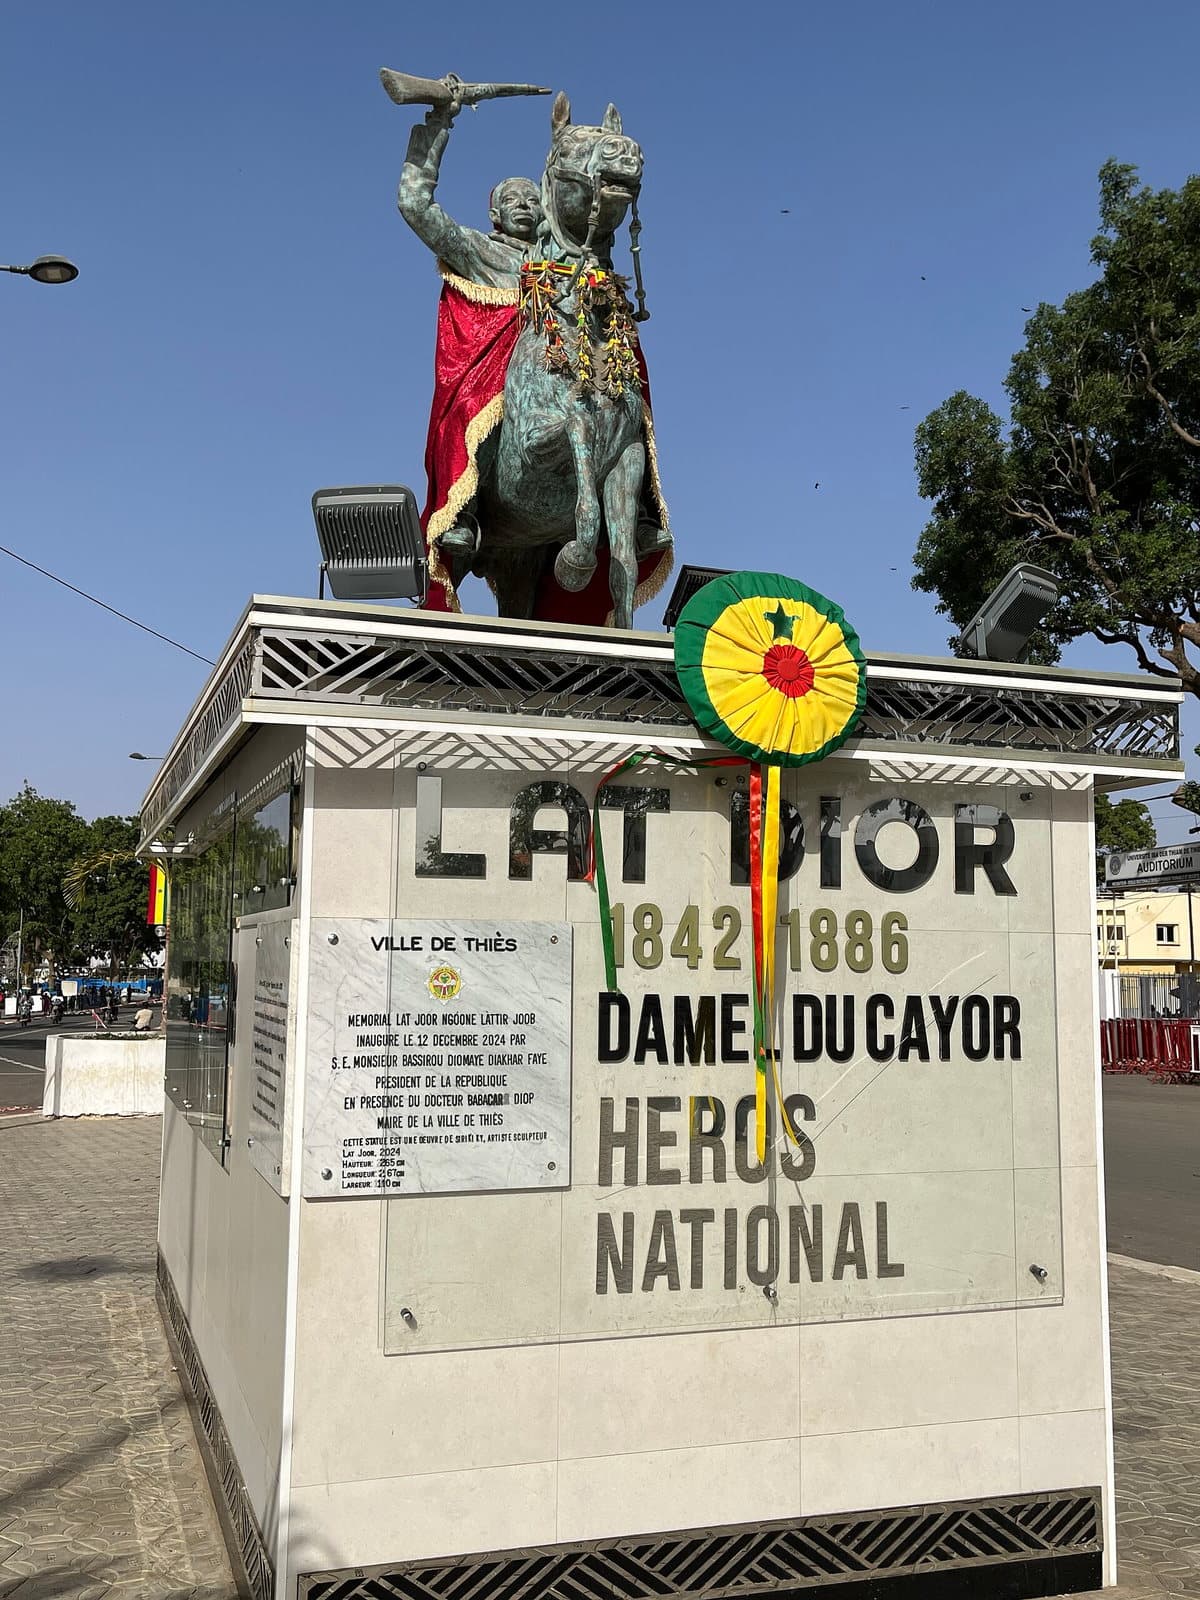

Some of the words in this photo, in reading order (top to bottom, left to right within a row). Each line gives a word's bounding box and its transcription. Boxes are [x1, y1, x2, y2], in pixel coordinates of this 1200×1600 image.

[415, 775, 670, 884] LAT
[731, 791, 1018, 896] DIOR
[1137, 857, 1193, 873] AUDITORIUM
[371, 936, 423, 951] VILLE
[431, 937, 456, 951] DE
[464, 931, 517, 952] THIÈS
[610, 902, 742, 970] 1842
[781, 908, 909, 974] 1886
[348, 1013, 391, 1027] MEMORIAL
[396, 1013, 411, 1026] LAT
[415, 1013, 437, 1026] JOOR
[513, 1013, 536, 1025] JOOB
[597, 991, 782, 1065] DAME
[793, 993, 855, 1064] DU
[866, 993, 1022, 1063] CAYOR
[356, 1034, 399, 1047] INAUGURE
[404, 1034, 413, 1046] LE
[417, 1034, 428, 1046] 12
[433, 1034, 478, 1046] DECEMBRE
[482, 1034, 505, 1046] 2024
[510, 1034, 526, 1045] PAR
[353, 1055, 398, 1068] MONSIEUR
[402, 1054, 443, 1066] BASSIROU
[447, 1054, 484, 1066] DIOMAYE
[488, 1054, 523, 1066] DIAKHAR
[527, 1053, 547, 1065] FAYE
[375, 1076, 421, 1089] PRESIDENT
[425, 1075, 436, 1087] DE
[440, 1075, 451, 1087] LA
[455, 1074, 508, 1088] REPUBLIQUE
[344, 1096, 355, 1110] EN
[360, 1095, 404, 1109] PRESENCE
[408, 1095, 420, 1107] DU
[424, 1094, 463, 1107] DOCTEUR
[514, 1092, 535, 1105] DIOP
[377, 1115, 403, 1129] MAIRE
[407, 1115, 418, 1128] DE
[423, 1115, 433, 1127] LA
[437, 1114, 460, 1127] VILLE
[464, 1114, 475, 1126] DE
[343, 1138, 363, 1147] CETTE
[365, 1136, 387, 1146] STATUE
[390, 1136, 401, 1145] EST
[403, 1135, 418, 1144] UNE
[444, 1134, 453, 1143] DE
[487, 1133, 511, 1142] ARTISTE
[513, 1131, 547, 1142] SCULPTEUR
[598, 1093, 816, 1187] HEROS
[380, 1147, 400, 1156] 2024
[595, 1201, 905, 1295] NATIONAL
